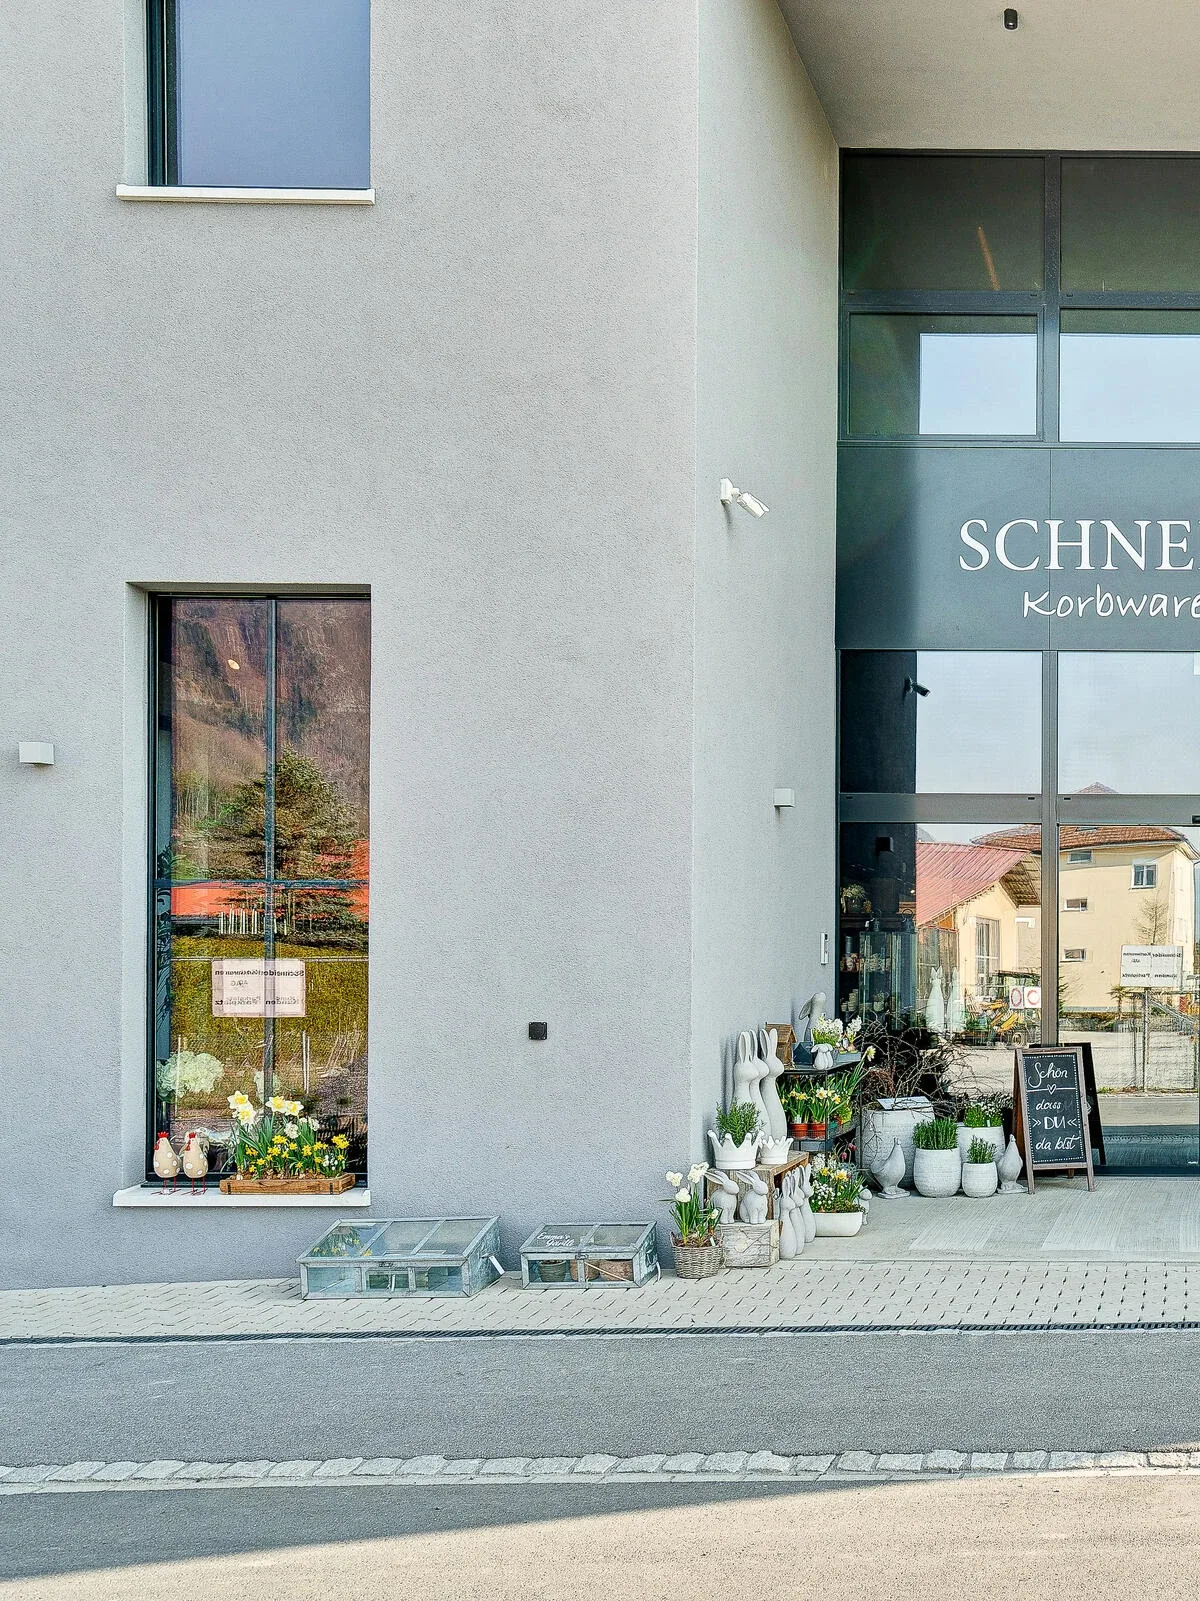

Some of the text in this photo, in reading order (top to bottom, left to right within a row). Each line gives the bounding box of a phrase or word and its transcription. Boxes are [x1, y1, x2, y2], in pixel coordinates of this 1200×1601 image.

[1028, 1061, 1068, 1088] Schön
[1036, 1099, 1061, 1111] dass
[1036, 1136, 1081, 1150] da bist
